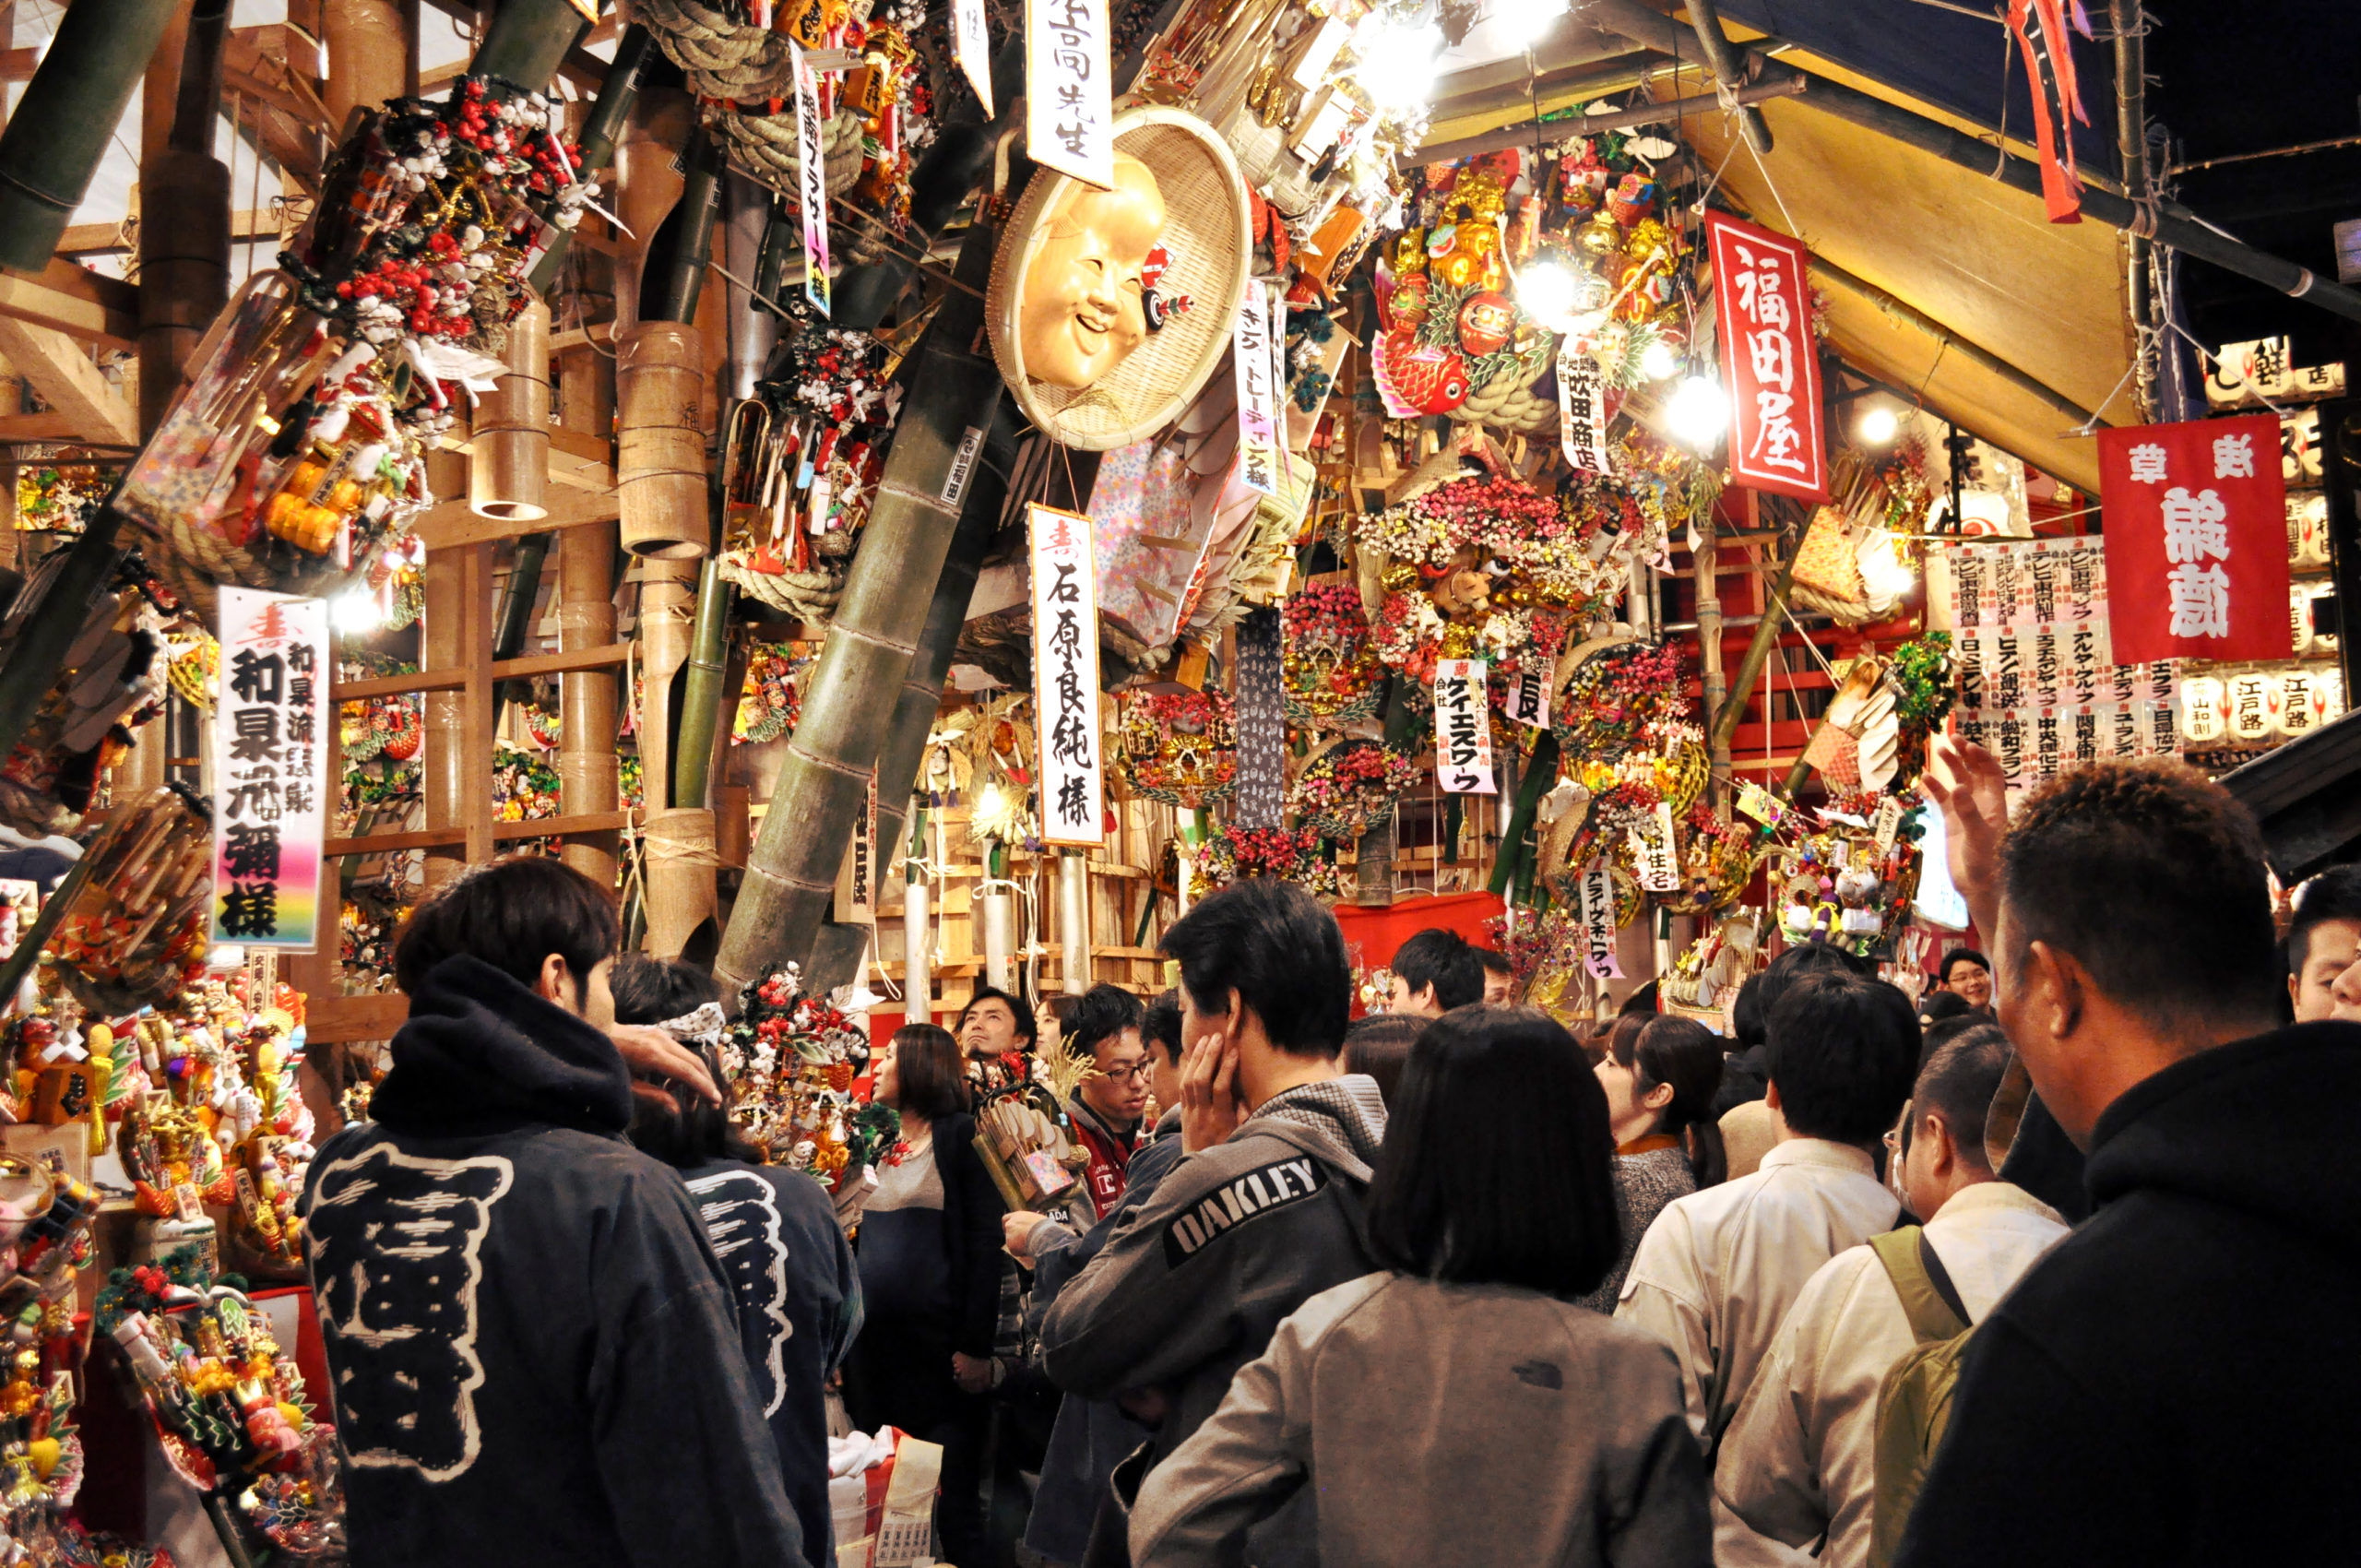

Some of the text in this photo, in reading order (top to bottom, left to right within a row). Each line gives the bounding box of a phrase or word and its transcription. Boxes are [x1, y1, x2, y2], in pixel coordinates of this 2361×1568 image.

[1049, 0, 1096, 159] 高先生
[1240, 306, 1270, 490] キング・トレーディング様
[1568, 371, 1601, 473] 吹田商店
[1735, 244, 1805, 473] 福田屋
[1047, 562, 1093, 826] 石原良純様
[1447, 676, 1480, 790] ケイエスワーク
[2236, 681, 2264, 731] 江戸路
[2284, 678, 2309, 729] 江戸路
[219, 647, 286, 938] 和泉元彌様
[1172, 1158, 1317, 1253] OAKLEY
